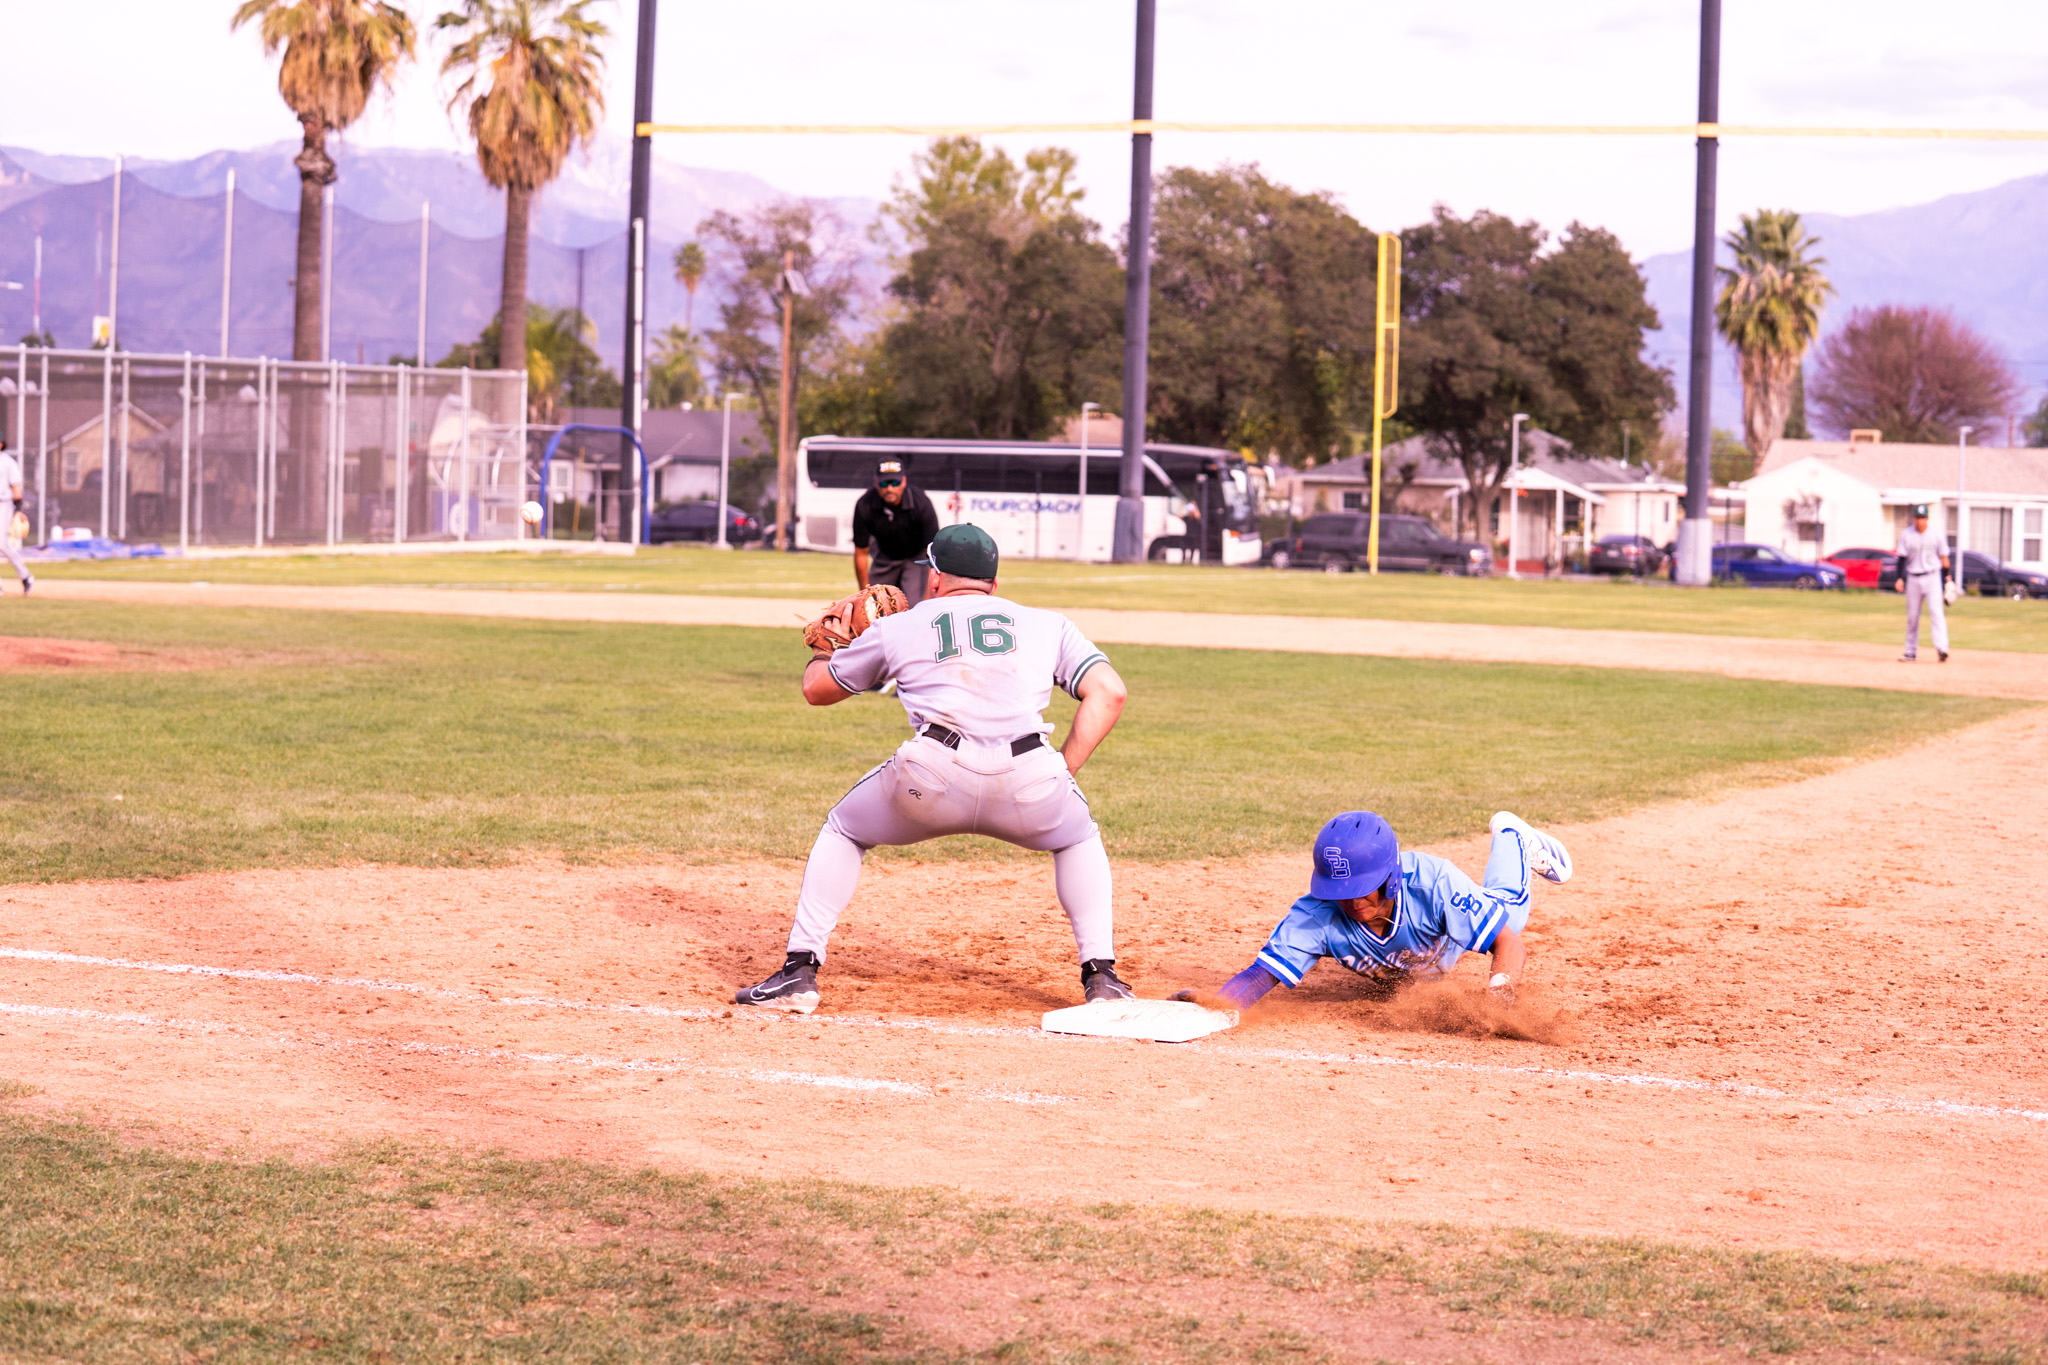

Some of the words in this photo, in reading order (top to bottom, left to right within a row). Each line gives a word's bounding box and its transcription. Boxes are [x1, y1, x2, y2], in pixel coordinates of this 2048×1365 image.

[931, 612, 1016, 663] 16
[1324, 846, 1351, 879] SB
[1450, 890, 1484, 919] SB
